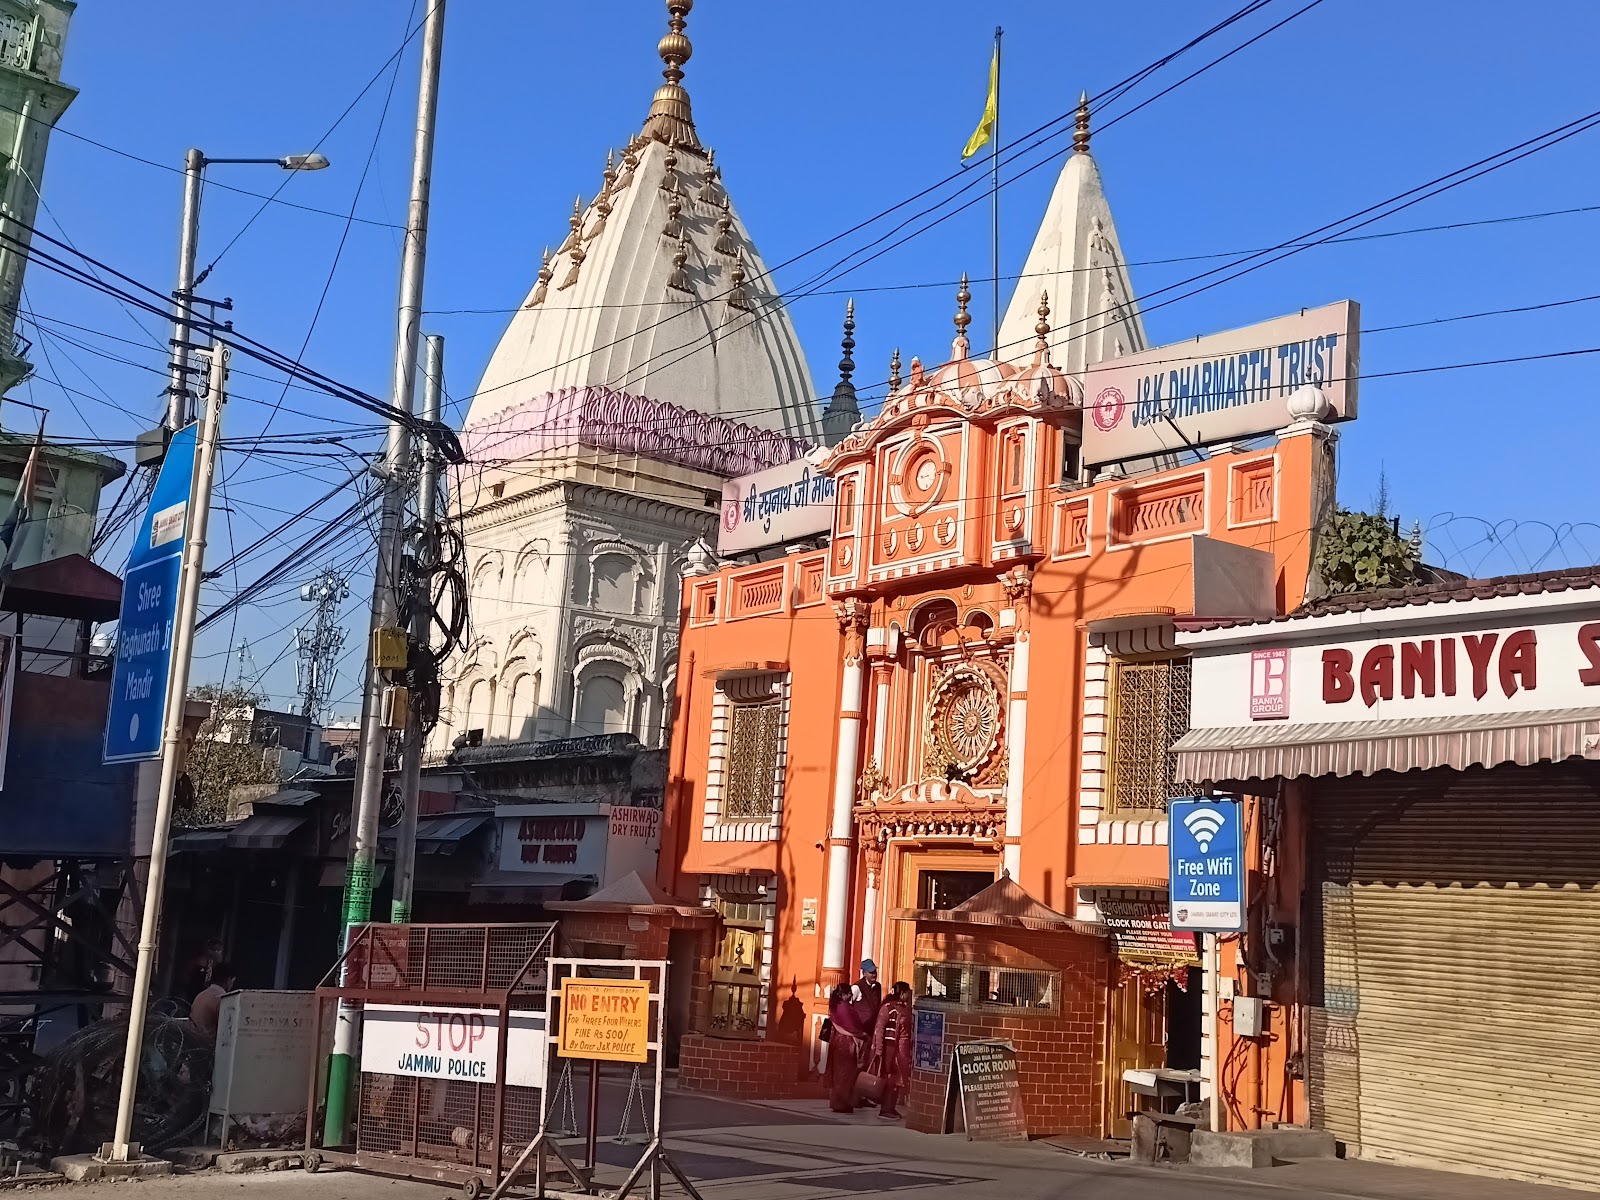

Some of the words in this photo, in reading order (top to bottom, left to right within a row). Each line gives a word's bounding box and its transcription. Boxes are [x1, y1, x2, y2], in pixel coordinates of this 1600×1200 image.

[1132, 372, 1165, 428] J&K
[1168, 348, 1272, 418] DHARMARTH
[1278, 333, 1337, 398] TRUST
[743, 482, 757, 523] श्री
[794, 466, 810, 508] जी
[138, 582, 162, 612] Shree
[119, 622, 160, 662] Raghunath
[162, 620, 172, 652] Ji
[1253, 652, 1271, 660] SINCE
[1322, 628, 1538, 709] BANIYA
[124, 669, 154, 702] Mandir
[1252, 696, 1283, 705] BANIYA
[1252, 704, 1284, 713] GROUP
[611, 808, 659, 824] ASHIRWAD
[612, 824, 628, 836] DRY
[630, 825, 656, 838] FRUITS
[1178, 858, 1204, 876] Free
[1206, 857, 1233, 876] Wifi
[1189, 879, 1220, 896] Zone
[1101, 900, 1148, 917] RAGHUNATH
[1107, 918, 1130, 928] CLOCK
[1131, 919, 1152, 929] ROOM
[1152, 920, 1170, 930] GATE
[570, 994, 588, 1011] NO
[592, 995, 640, 1014] ENTRY
[582, 1014, 601, 1026] THREE
[603, 1016, 618, 1026] FOUR
[415, 1012, 486, 1054] STOP
[574, 1028, 590, 1038] FINE
[606, 1028, 628, 1042] 500/
[569, 1040, 579, 1050] By
[597, 1042, 610, 1051] J&K
[612, 1042, 636, 1052] POLICE
[398, 1053, 442, 1074] JAMMU
[448, 1058, 486, 1078] POLICE
[962, 1062, 991, 1075] CLOCK
[992, 1059, 1016, 1071] ROOM
[964, 1084, 983, 1092] PLEASE
[984, 1082, 1004, 1090] DEPOSIT
[1005, 1080, 1019, 1088] YOUR
